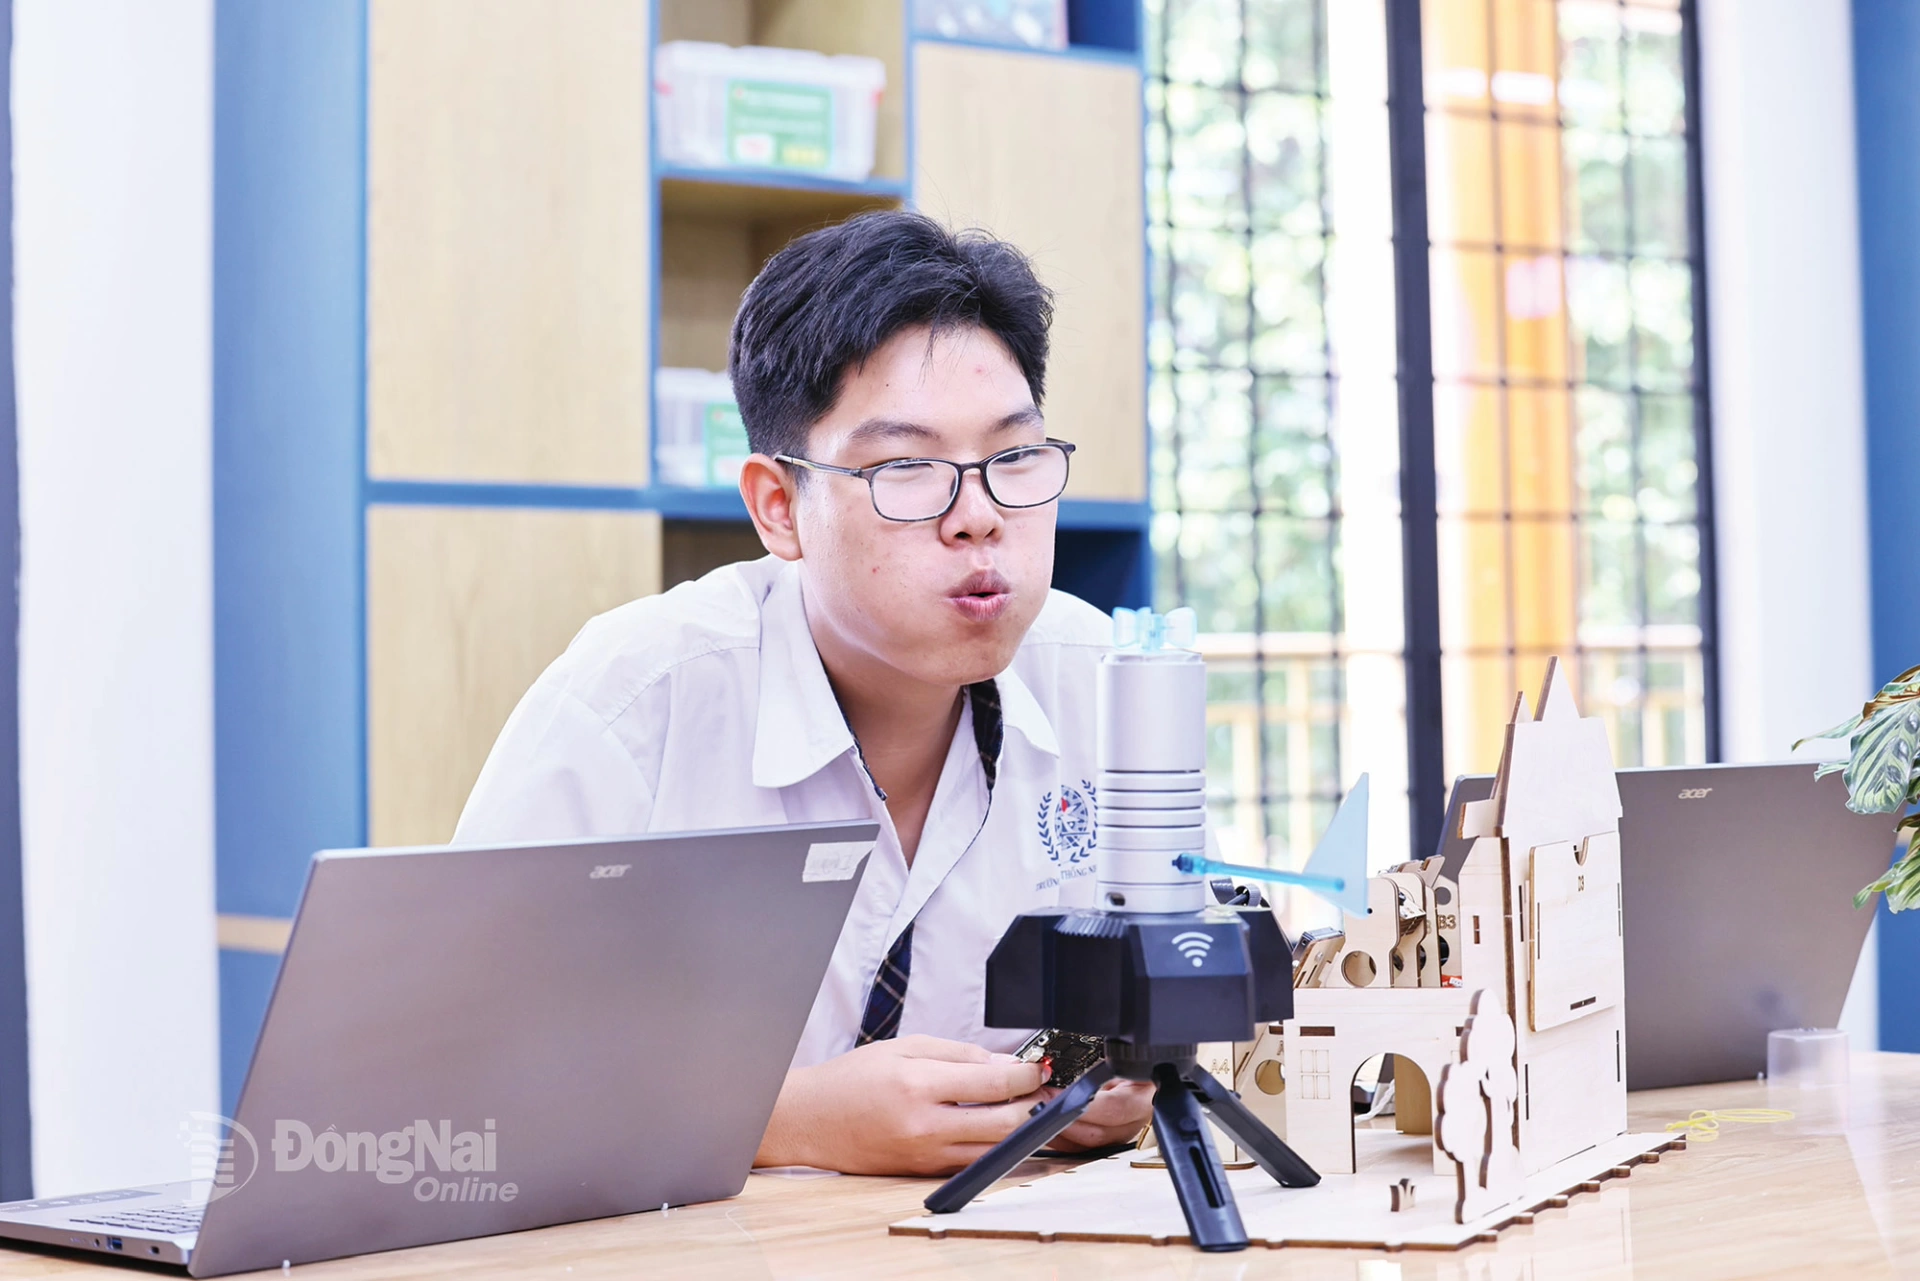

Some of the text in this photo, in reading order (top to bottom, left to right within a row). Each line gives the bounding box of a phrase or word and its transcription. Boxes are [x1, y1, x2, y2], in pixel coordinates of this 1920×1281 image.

[1678, 787, 1712, 799] acer
[590, 864, 632, 879] acer
[1437, 914, 1457, 931] B3
[1210, 1058, 1230, 1074] A4
